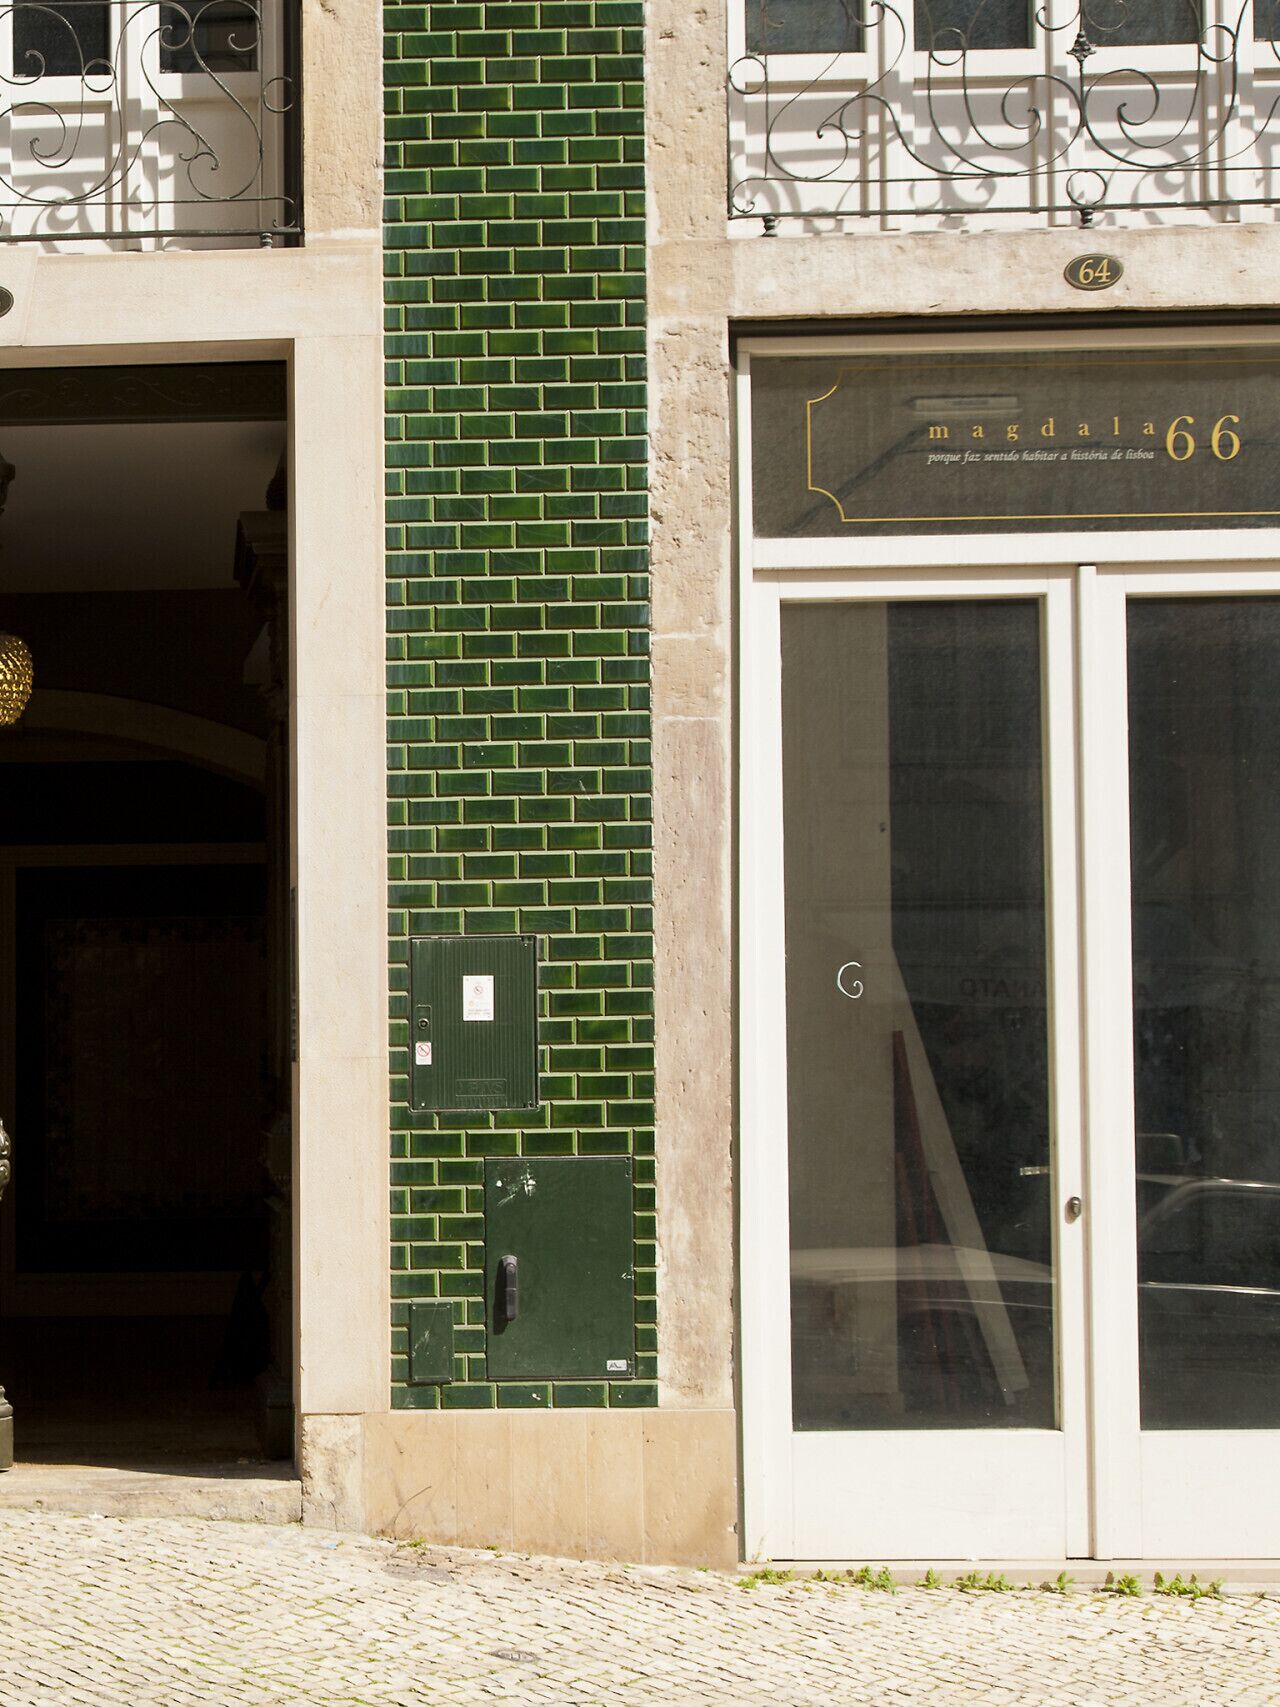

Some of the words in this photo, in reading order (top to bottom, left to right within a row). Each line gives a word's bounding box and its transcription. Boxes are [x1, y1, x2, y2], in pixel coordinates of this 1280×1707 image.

[1078, 259, 1111, 284] 64
[926, 454, 961, 465] porque
[961, 450, 981, 465] faz
[983, 450, 1020, 462] sentido
[1022, 450, 1059, 461] habitar
[1070, 449, 1108, 461] história
[1110, 449, 1124, 460] de
[1125, 448, 1155, 460] lisboa
